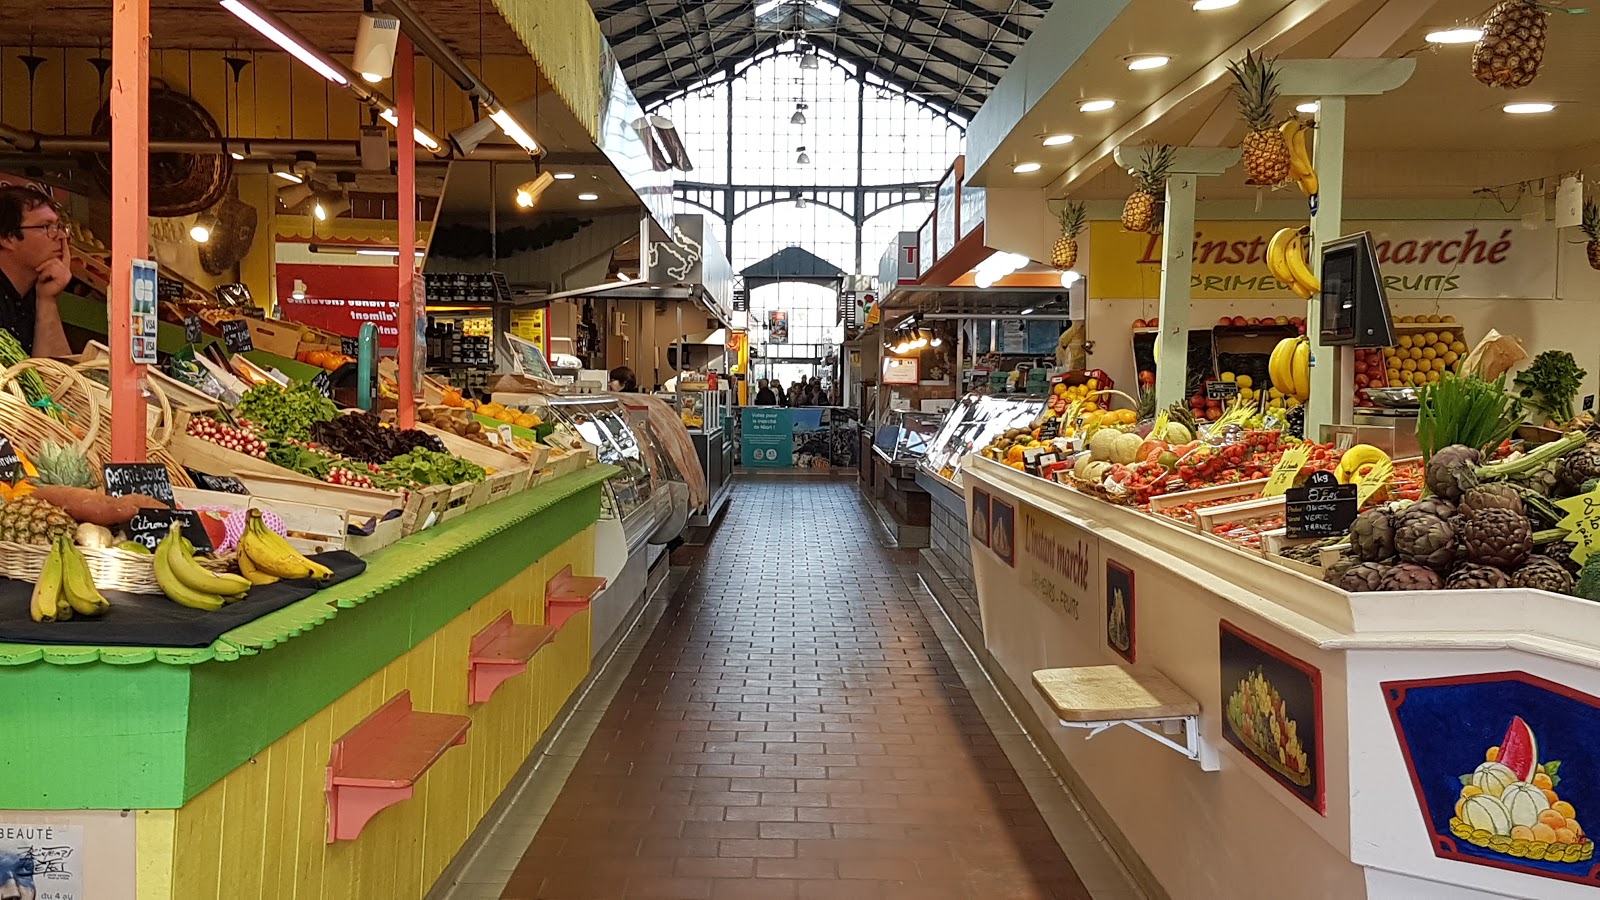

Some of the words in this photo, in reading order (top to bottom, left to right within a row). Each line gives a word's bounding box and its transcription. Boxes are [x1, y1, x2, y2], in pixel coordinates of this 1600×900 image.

[1383, 274, 1460, 291] RUITS
[145, 321, 155, 330] VISA
[145, 341, 155, 351] VISA
[1311, 472, 1329, 484] 1kg
[131, 515, 168, 531] Citrons
[1304, 523, 1333, 531] FRANCE
[1057, 539, 1088, 591] marché
